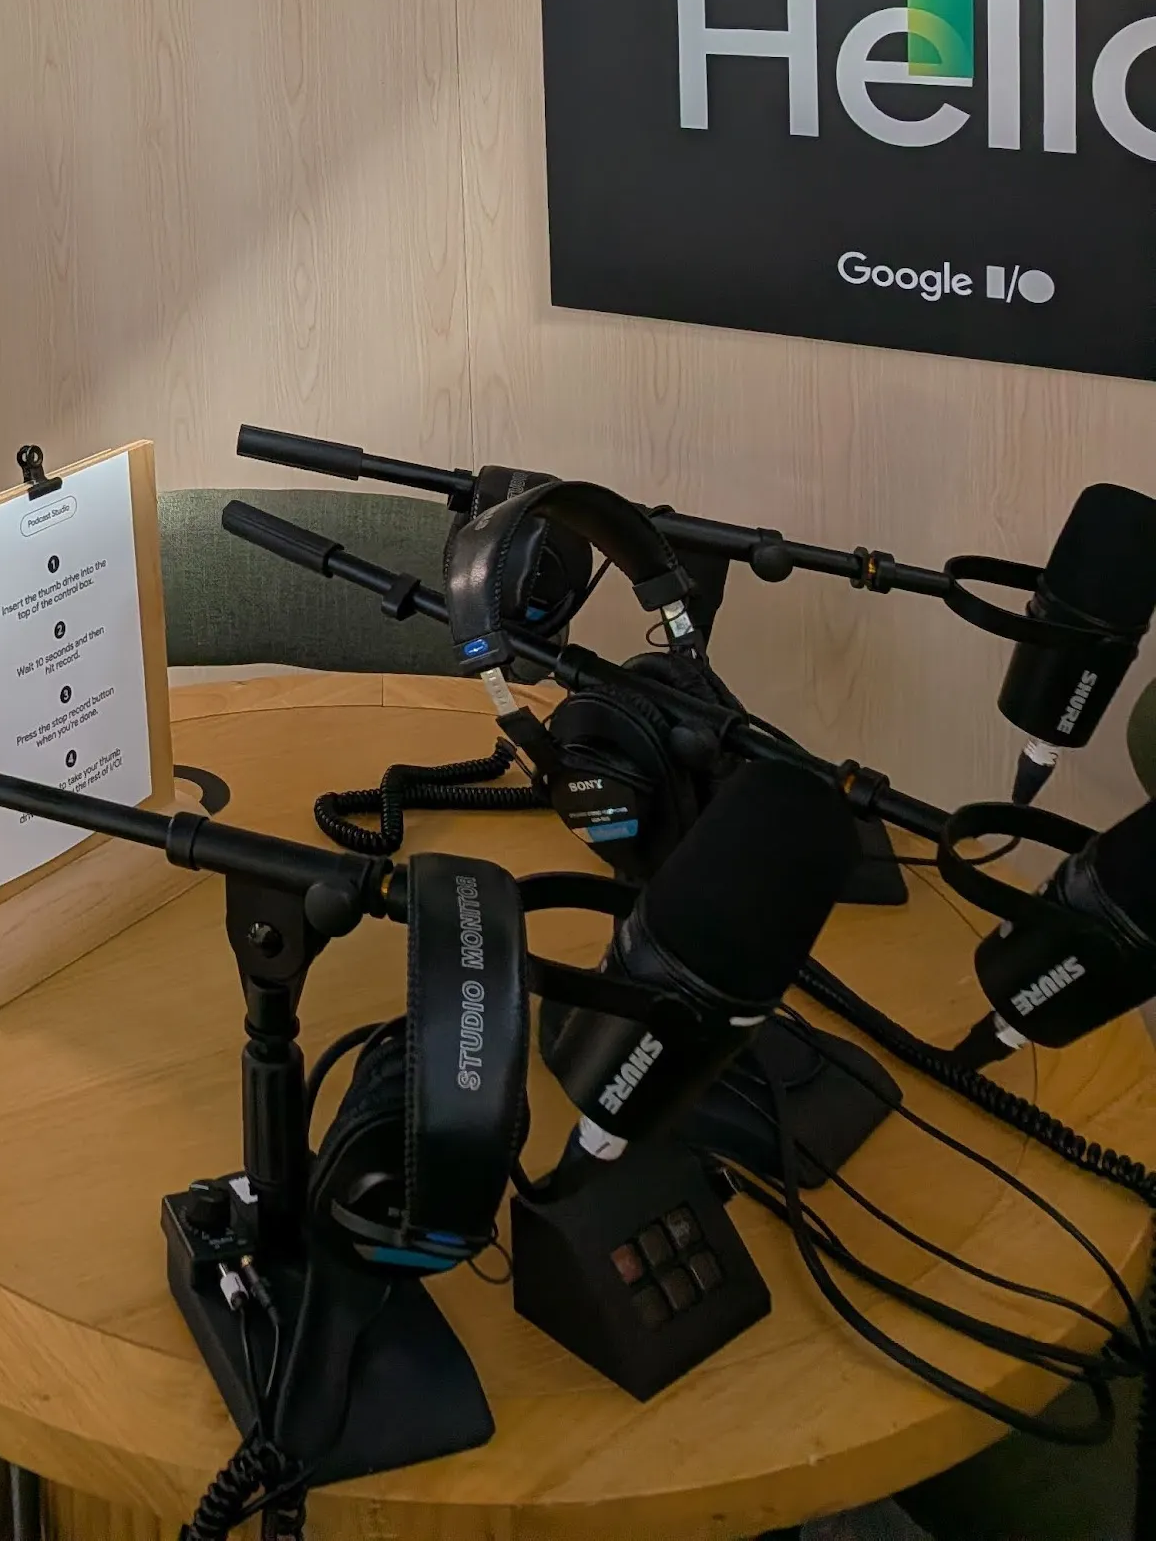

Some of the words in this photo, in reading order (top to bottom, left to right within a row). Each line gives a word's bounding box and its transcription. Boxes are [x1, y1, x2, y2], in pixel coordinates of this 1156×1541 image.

[837, 251, 973, 302] Google
[986, 265, 1055, 303] I/O
[27, 512, 51, 528] Podcast
[51, 504, 70, 518] Studio
[1, 598, 24, 616] Insert
[25, 593, 37, 605] the
[38, 581, 61, 597] thumb
[62, 572, 80, 587] drive
[80, 566, 94, 578] into
[94, 559, 107, 571] the
[17, 608, 31, 620] top
[31, 602, 40, 613] of
[41, 598, 53, 610] the
[54, 584, 79, 603] control
[79, 577, 95, 590] box.
[16, 662, 34, 677] Wait
[35, 657, 44, 669] 10
[45, 643, 74, 664] seconds
[74, 633, 88, 648] and
[88, 626, 105, 640] then
[45, 664, 55, 675] hit
[55, 650, 81, 670] record.
[16, 730, 37, 746] Press
[38, 722, 51, 735] the
[51, 714, 68, 728] stop
[68, 698, 91, 719] record
[91, 687, 115, 704] button
[1057, 669, 1098, 735] SHURE
[36, 732, 57, 748] when
[57, 720, 79, 738] you're
[79, 708, 99, 724] done.
[67, 773, 83, 786] take
[83, 762, 99, 779] your
[99, 747, 121, 766] thumb
[75, 781, 87, 793] the
[87, 770, 101, 785] rest
[101, 765, 109, 777] of
[568, 778, 603, 792] SONY
[455, 875, 484, 970] MONITOR
[1010, 956, 1086, 1016] SHURE
[457, 980, 485, 1091] STUDIO
[598, 1031, 663, 1115] SHURE
